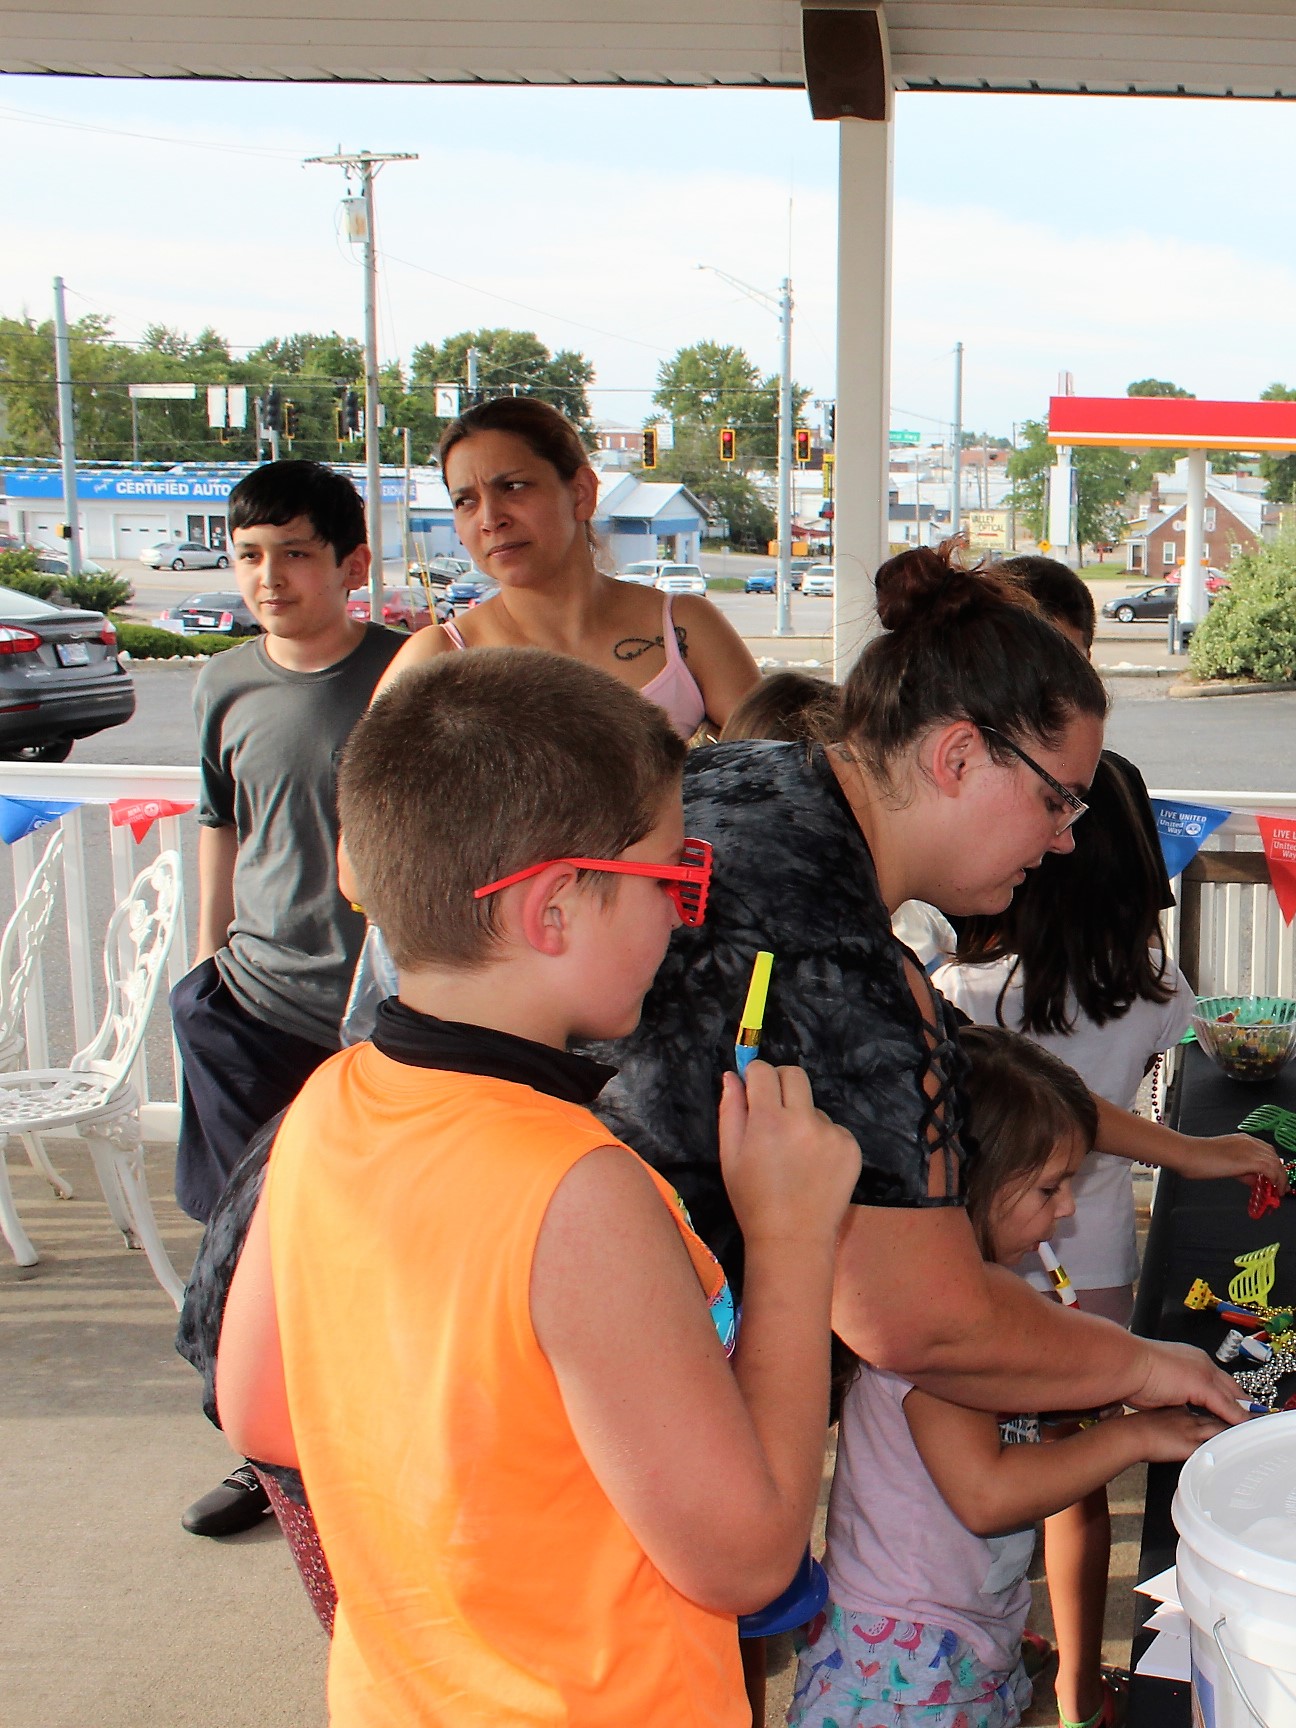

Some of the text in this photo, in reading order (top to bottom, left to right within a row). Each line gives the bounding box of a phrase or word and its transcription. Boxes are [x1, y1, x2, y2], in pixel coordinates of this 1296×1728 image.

[116, 481, 189, 495] CERTIFIED
[192, 483, 232, 496] AUTO
[971, 514, 994, 523] VALLEY
[977, 523, 1004, 532] OPTICAL
[1160, 809, 1207, 822] LIVE UNITED
[1160, 819, 1184, 828] United
[1167, 827, 1182, 836] Way
[1273, 829, 1291, 839] LIVE
